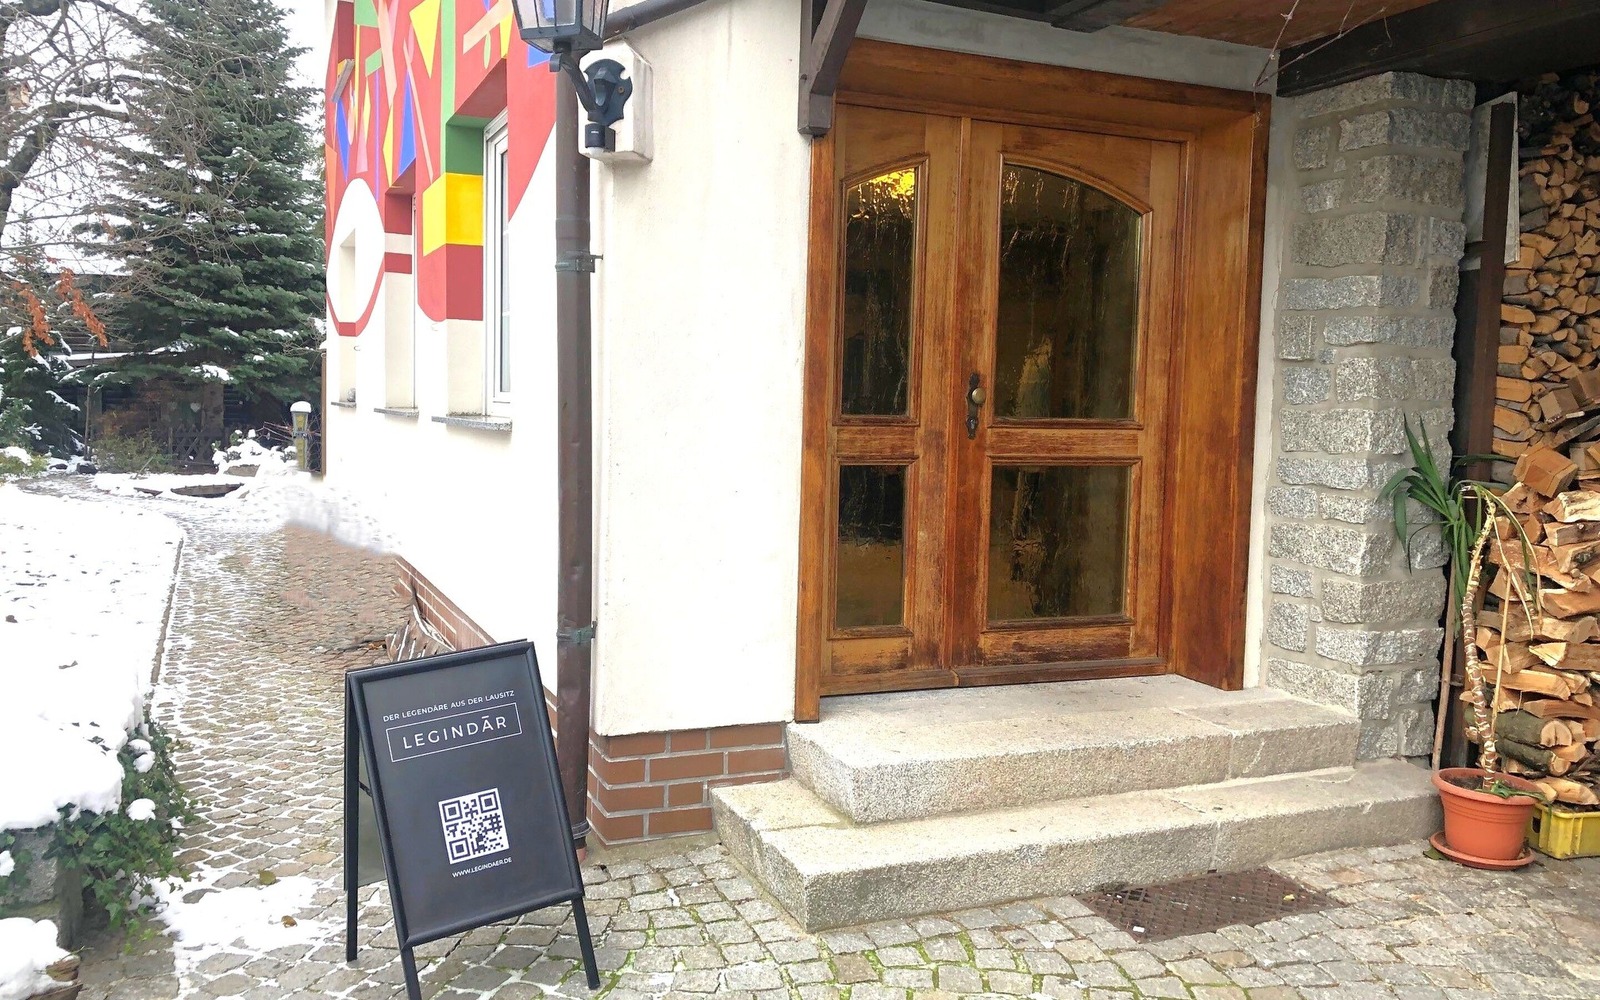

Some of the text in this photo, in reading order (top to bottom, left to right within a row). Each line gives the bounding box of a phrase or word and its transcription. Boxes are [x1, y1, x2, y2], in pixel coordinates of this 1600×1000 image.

[383, 690, 515, 722] DER LEGENDÄRE AUS DER LAUSITZ
[452, 857, 512, 878] WWW.LEGINDAER.DE
